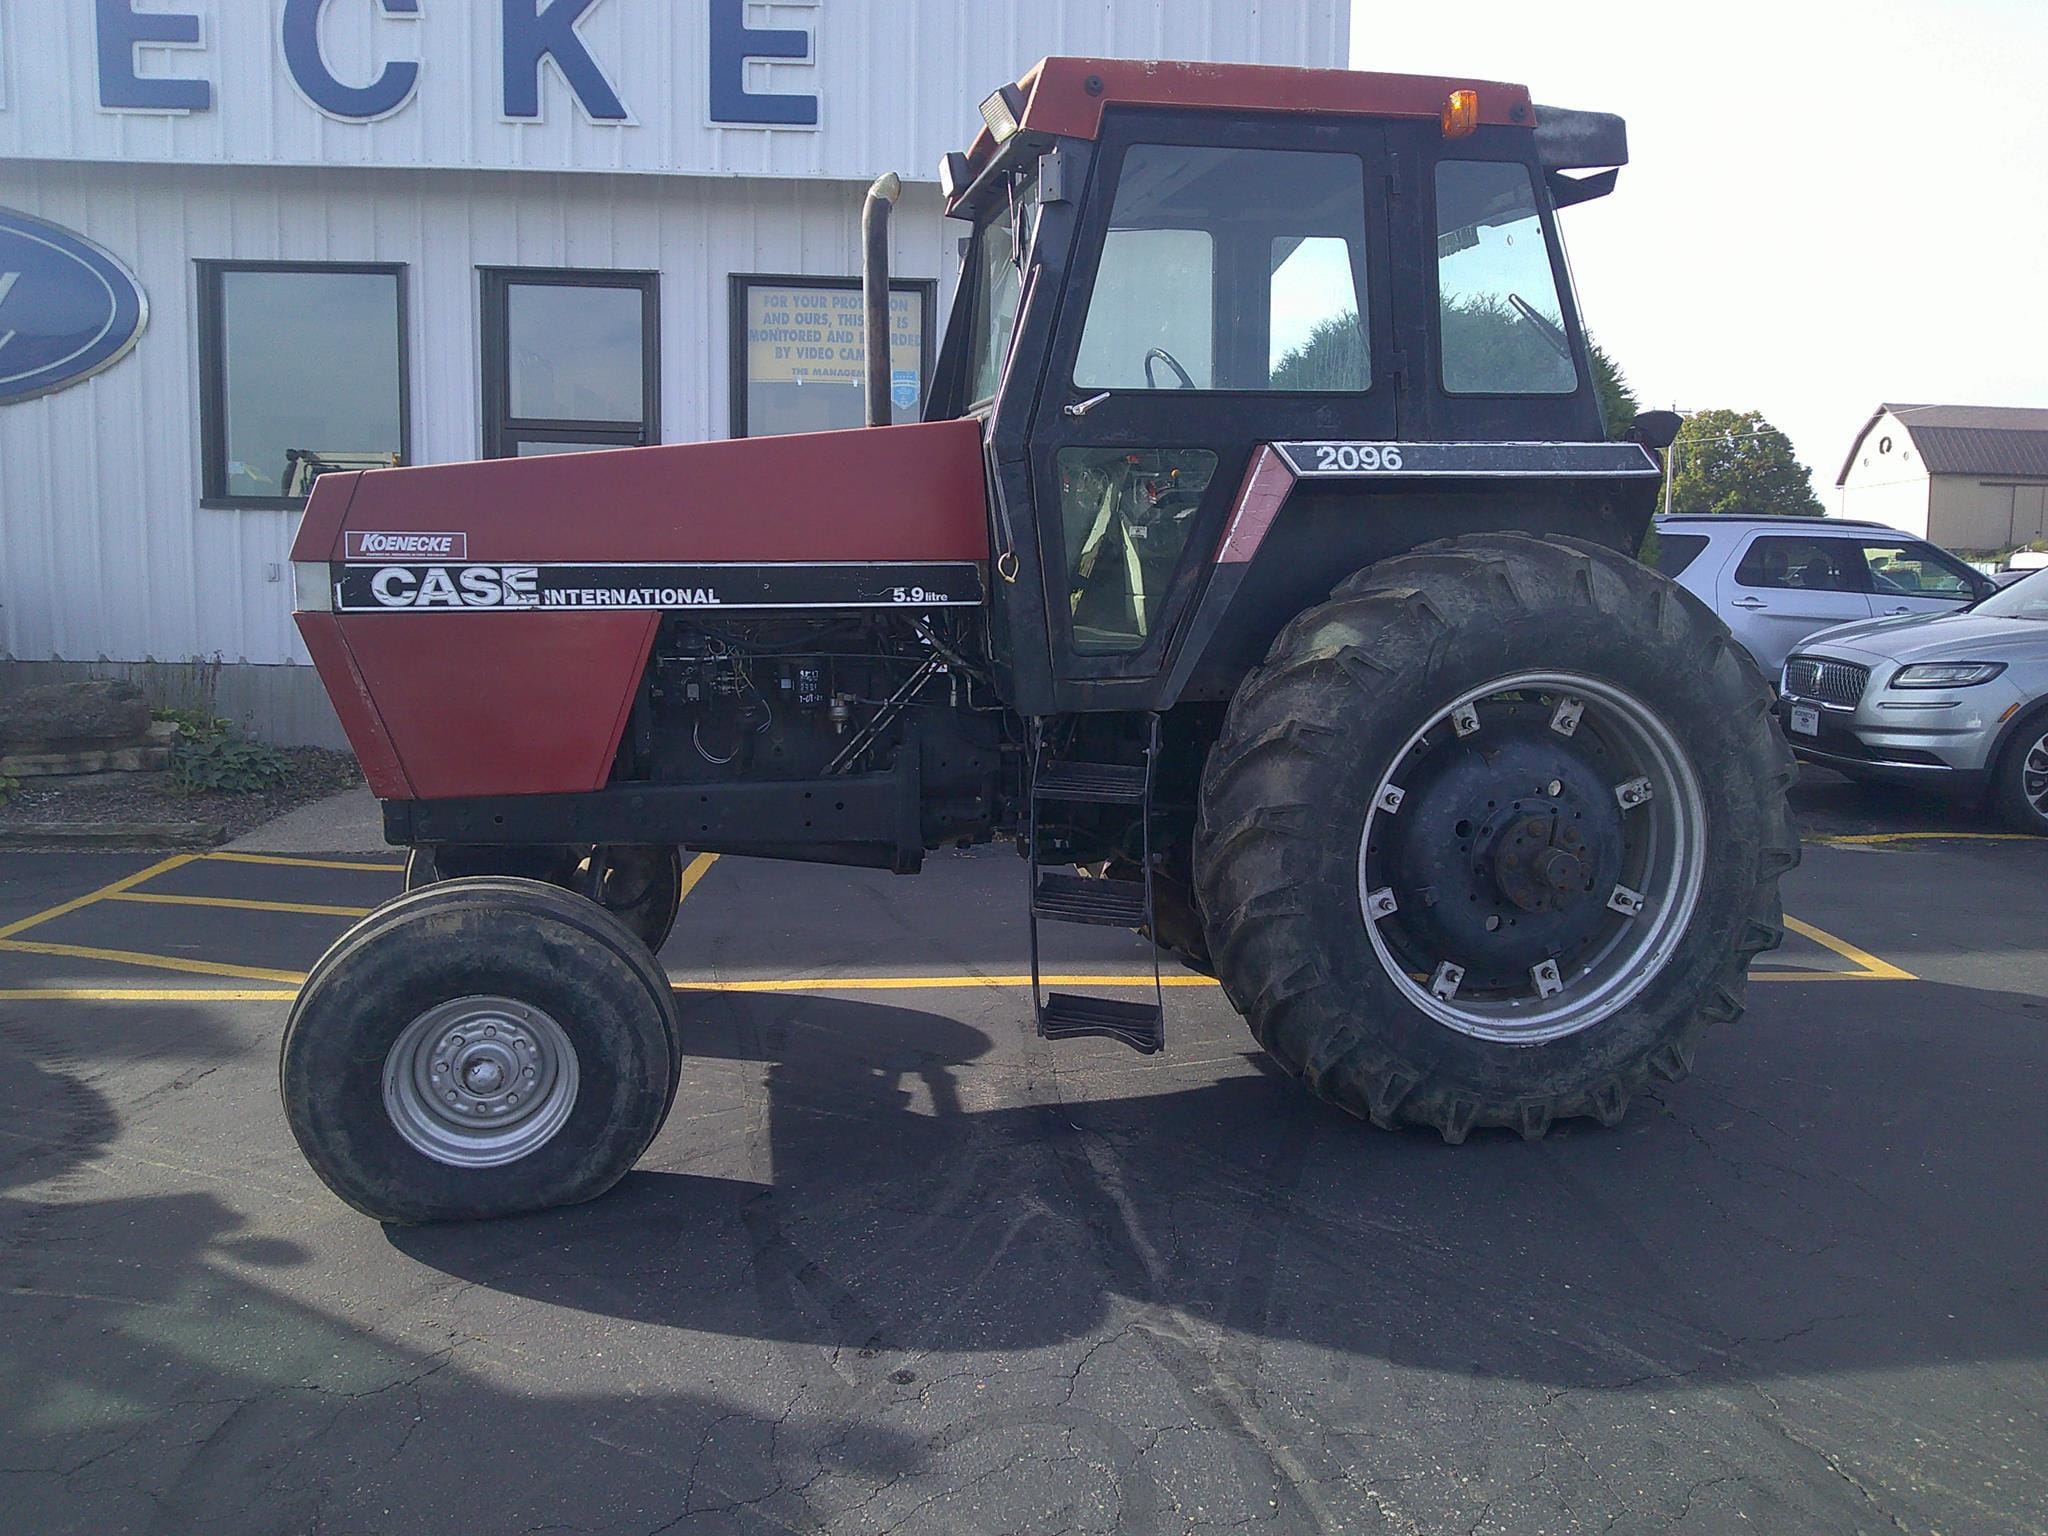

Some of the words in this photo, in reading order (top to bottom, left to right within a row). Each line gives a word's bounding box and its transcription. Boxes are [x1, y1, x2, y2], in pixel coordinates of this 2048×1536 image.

[763, 295, 789, 308] FOR
[793, 295, 828, 309] YOUR
[763, 313, 790, 326] AND
[795, 313, 833, 328] OURS,
[837, 313, 865, 328] THIS
[896, 316, 909, 329] IS
[749, 328, 822, 343] MONITORED
[827, 330, 855, 344] AND
[775, 346, 791, 360] BY
[796, 347, 834, 361] VIDEO
[792, 367, 809, 376] THE
[812, 368, 866, 378] MANAGEM
[1316, 446, 1403, 471] 2096
[360, 533, 453, 552] KOENECKE
[370, 567, 539, 606] CASE
[544, 588, 721, 605] INTERNATIONAL
[893, 586, 925, 602] 5.9
[925, 591, 949, 602] litre
